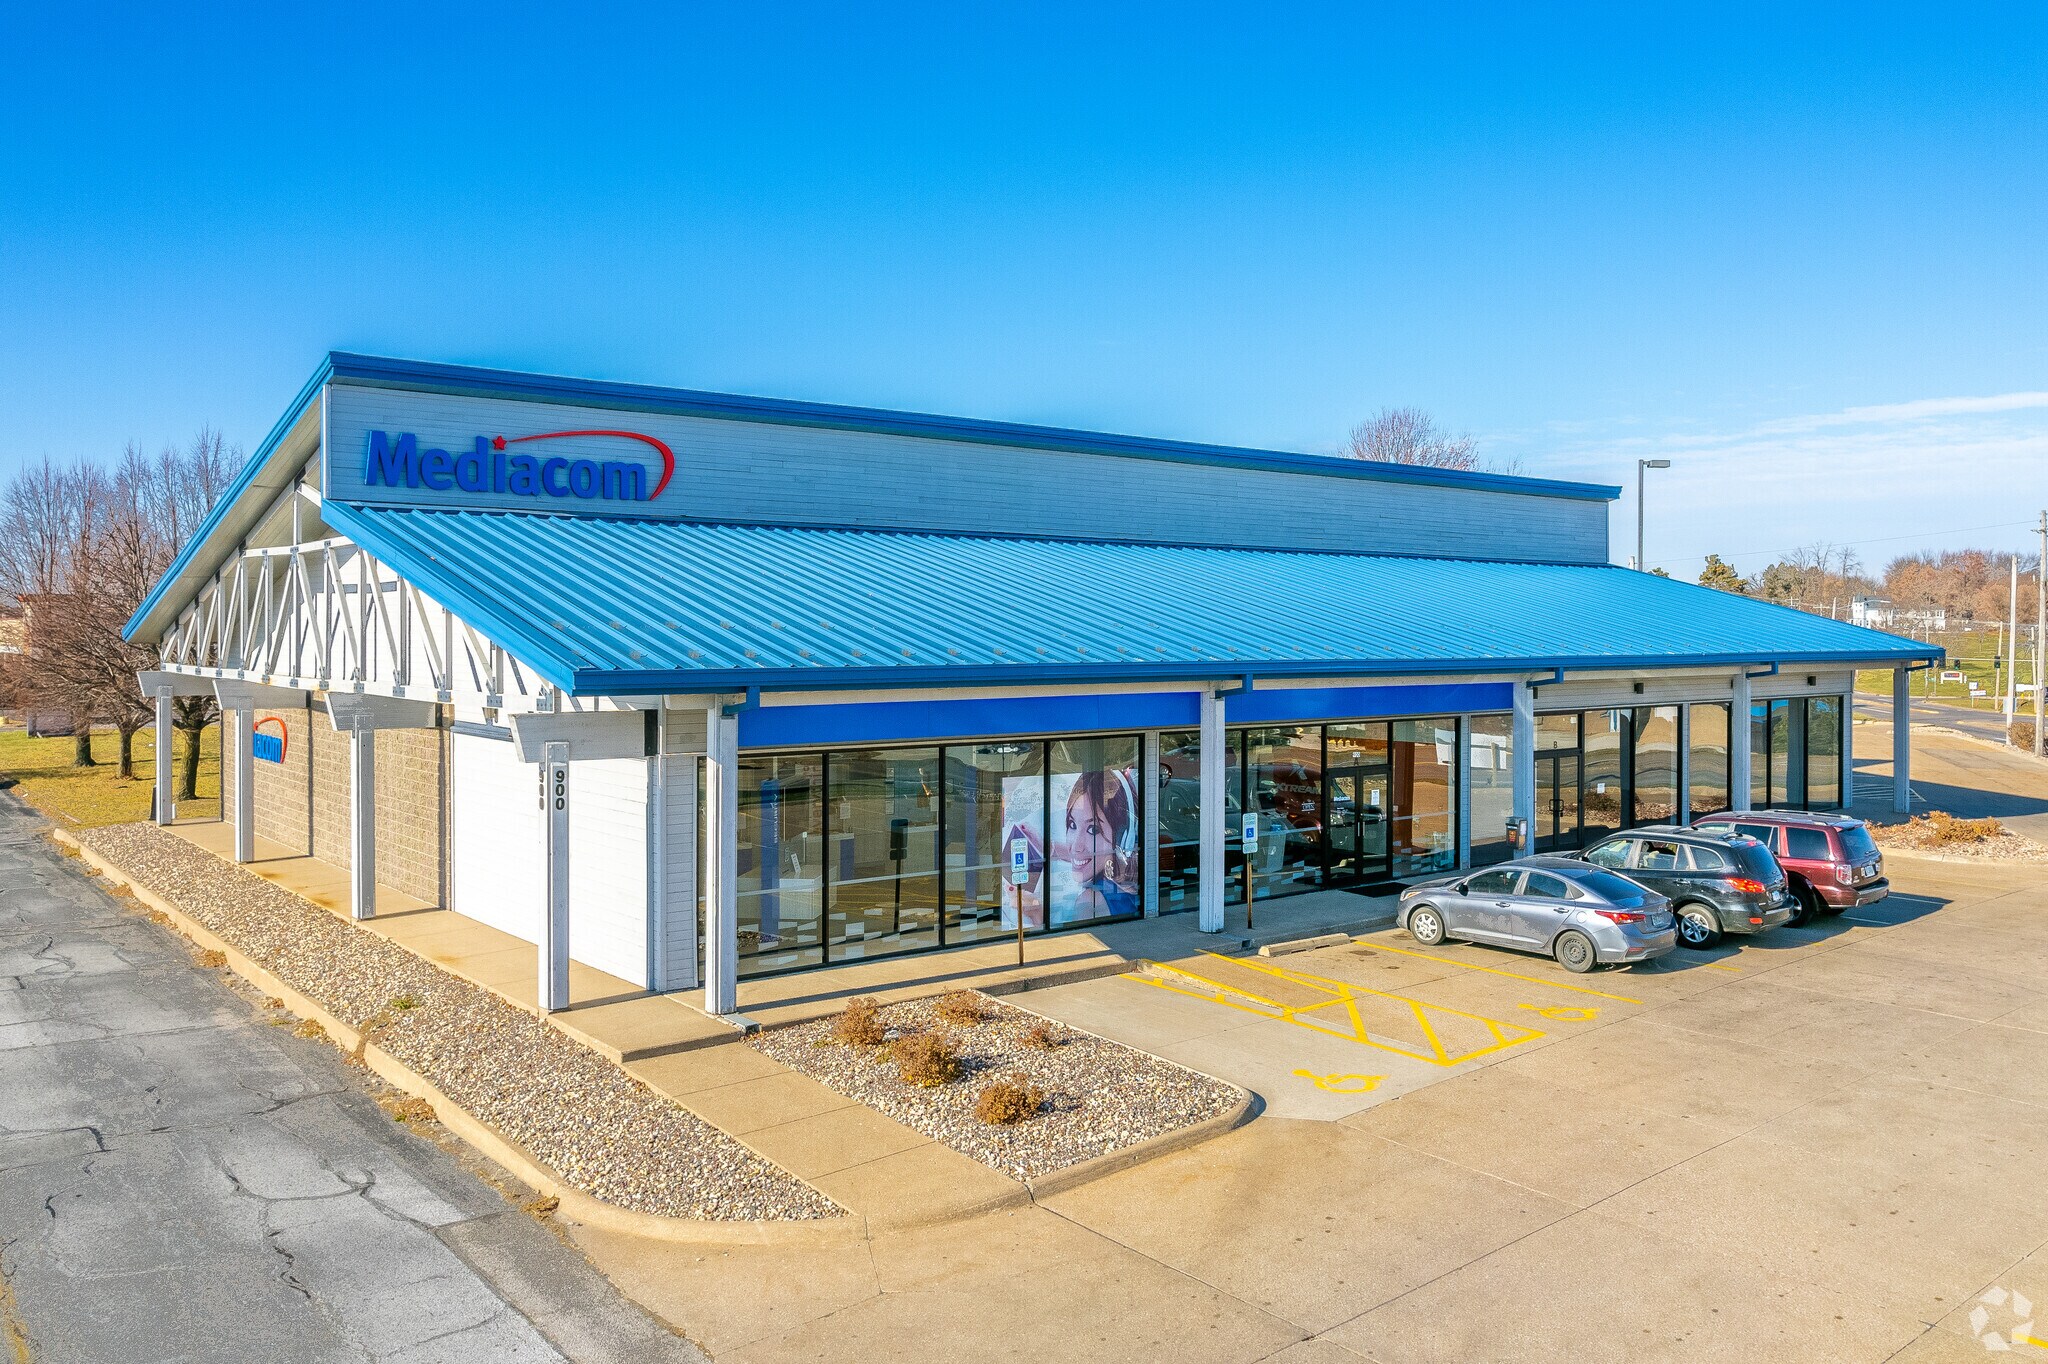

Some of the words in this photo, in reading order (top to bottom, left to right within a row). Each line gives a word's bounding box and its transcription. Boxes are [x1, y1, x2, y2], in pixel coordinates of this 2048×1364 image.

[364, 430, 647, 501] Mediacom
[253, 732, 282, 763] iacom
[556, 770, 564, 810] 900
